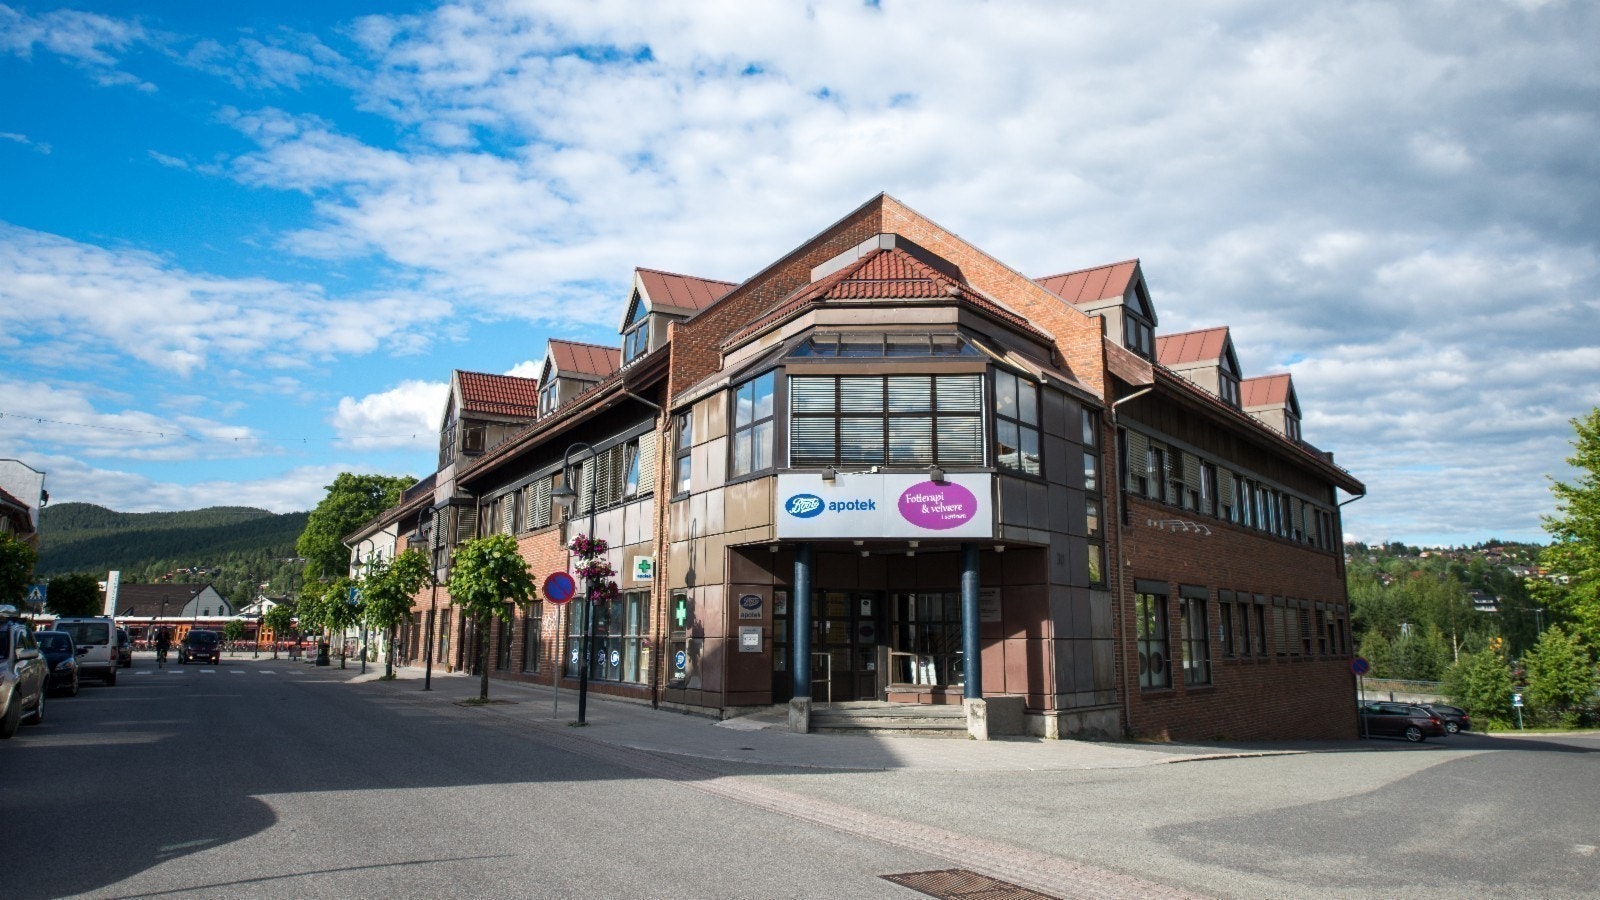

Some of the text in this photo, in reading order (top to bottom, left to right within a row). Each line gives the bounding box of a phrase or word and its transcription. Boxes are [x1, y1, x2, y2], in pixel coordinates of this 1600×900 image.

[906, 492, 944, 504] Fotterapi
[789, 498, 876, 513] Boots apotek
[922, 505, 930, 513] &
